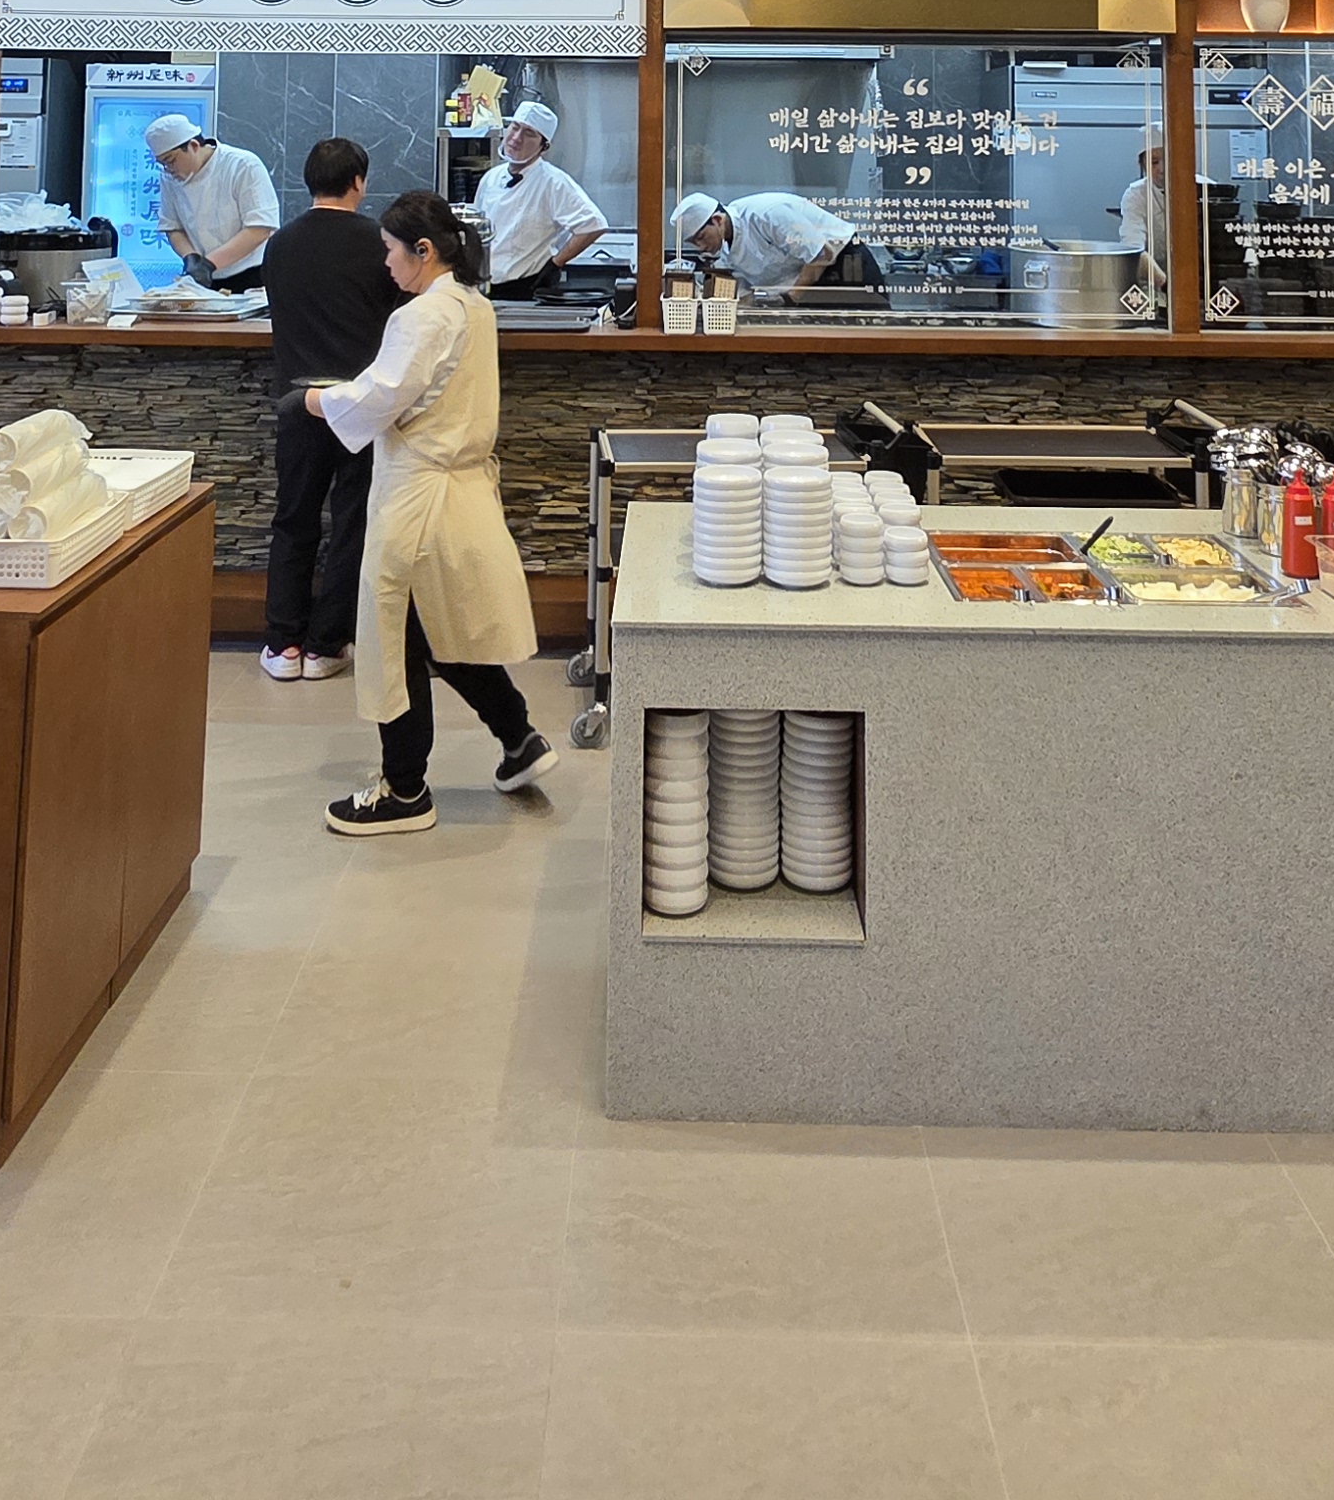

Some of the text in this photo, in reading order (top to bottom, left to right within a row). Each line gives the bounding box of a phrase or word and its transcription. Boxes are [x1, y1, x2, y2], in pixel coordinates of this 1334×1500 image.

[769, 107, 1058, 130] 매일 삶아내는 집보다 맛있는 건
[768, 132, 832, 154] 매시간
[836, 132, 919, 155] 삶아내는
[924, 133, 963, 155] 집의
[971, 134, 993, 156] 맛
[1237, 158, 1279, 179] 대를
[1285, 158, 1326, 179] 이은
[1269, 183, 1330, 205] 음식에
[878, 285, 952, 293] SHINJUOKMI
